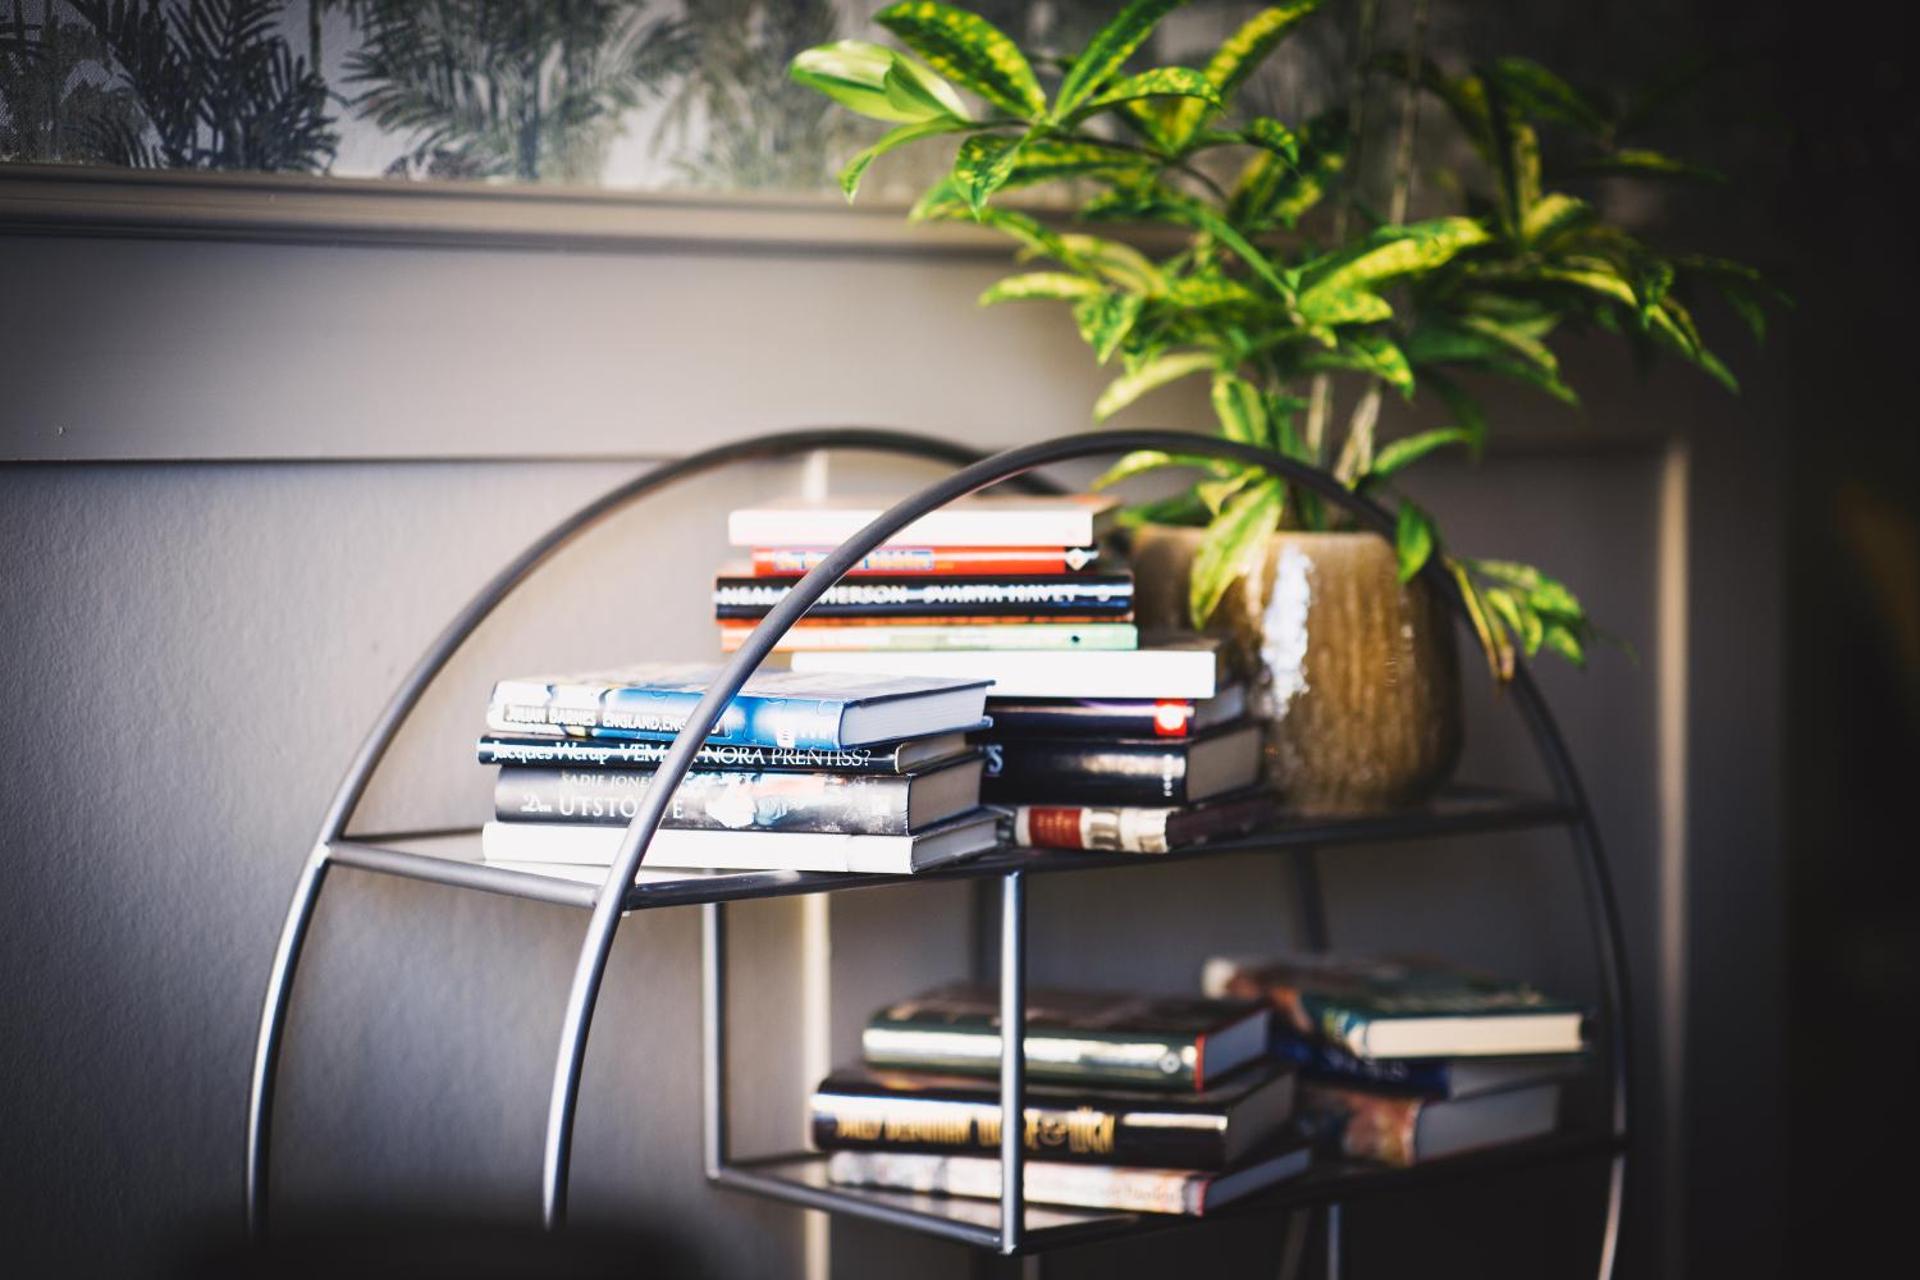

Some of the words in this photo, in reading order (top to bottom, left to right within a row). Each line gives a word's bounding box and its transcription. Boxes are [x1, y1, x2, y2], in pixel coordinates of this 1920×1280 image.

[491, 740, 554, 764] Jacques
[704, 745, 766, 765] NORA
[769, 747, 872, 767] PRENTISS?
[609, 776, 654, 790] JONE
